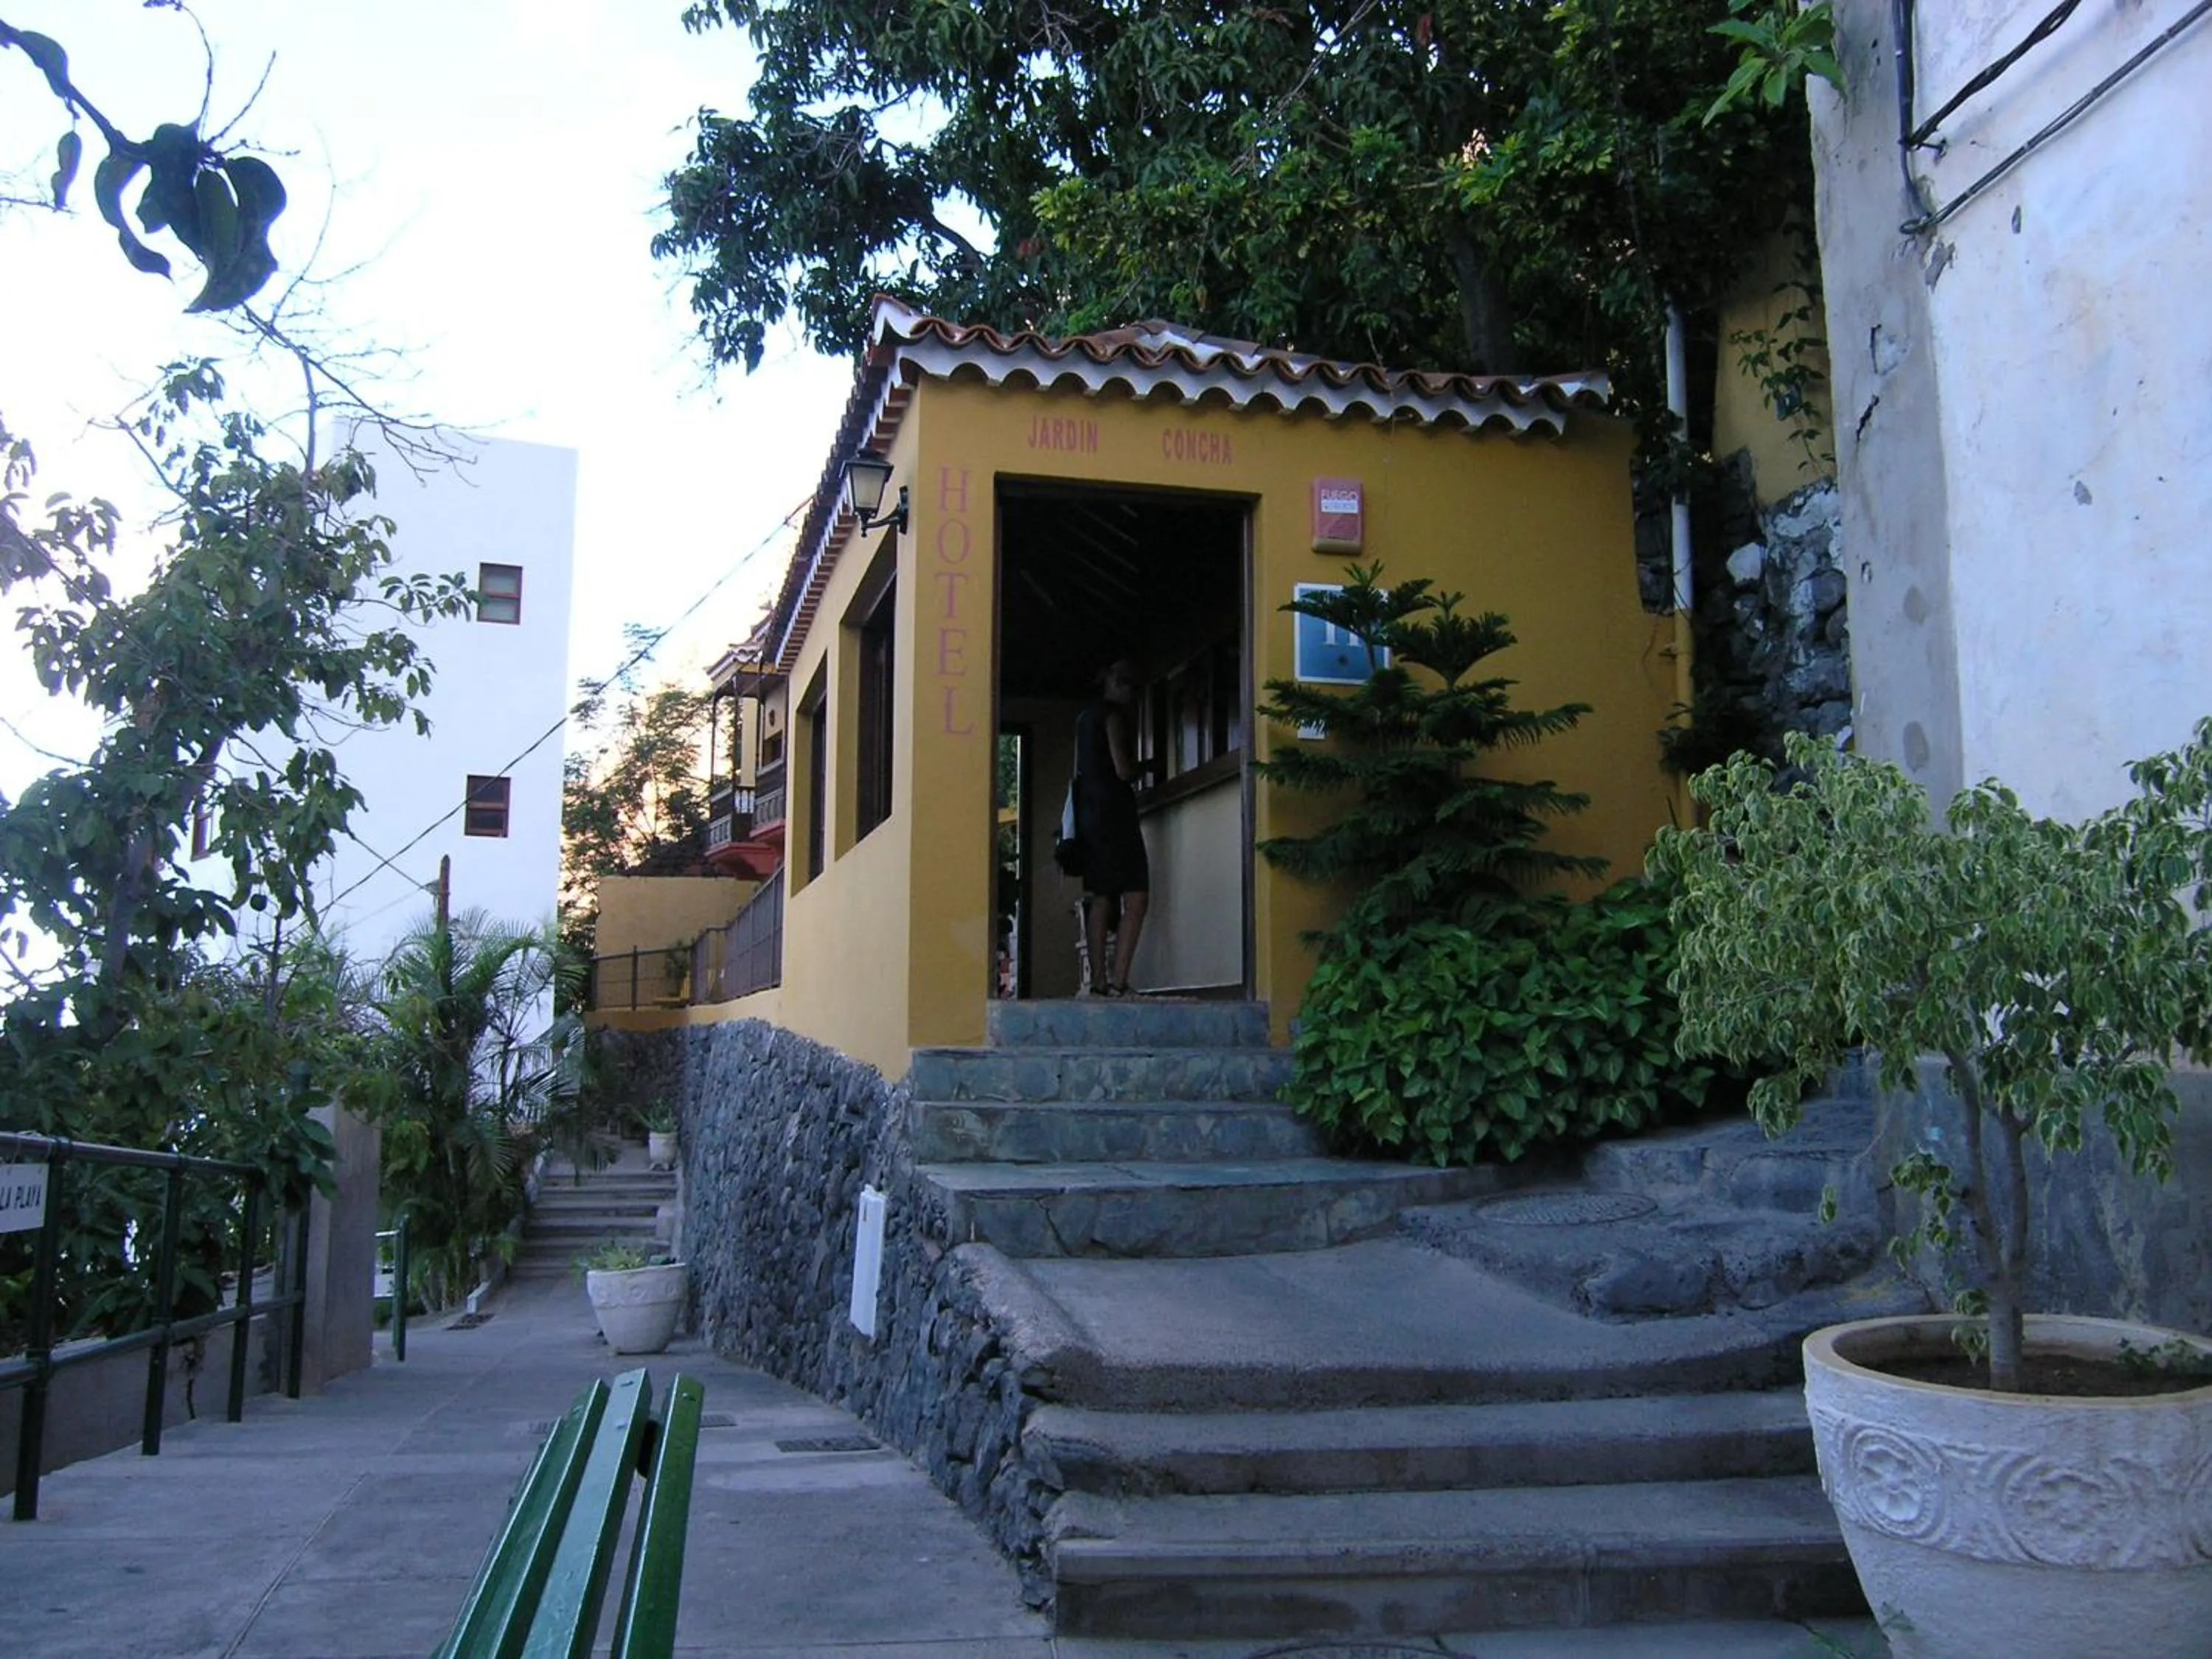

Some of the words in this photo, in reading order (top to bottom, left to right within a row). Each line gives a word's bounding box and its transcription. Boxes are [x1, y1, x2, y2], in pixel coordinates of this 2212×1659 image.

[1028, 414, 1099, 453] JARDIN
[1162, 427, 1233, 465] CONCHA
[933, 465, 975, 736] HOTEL
